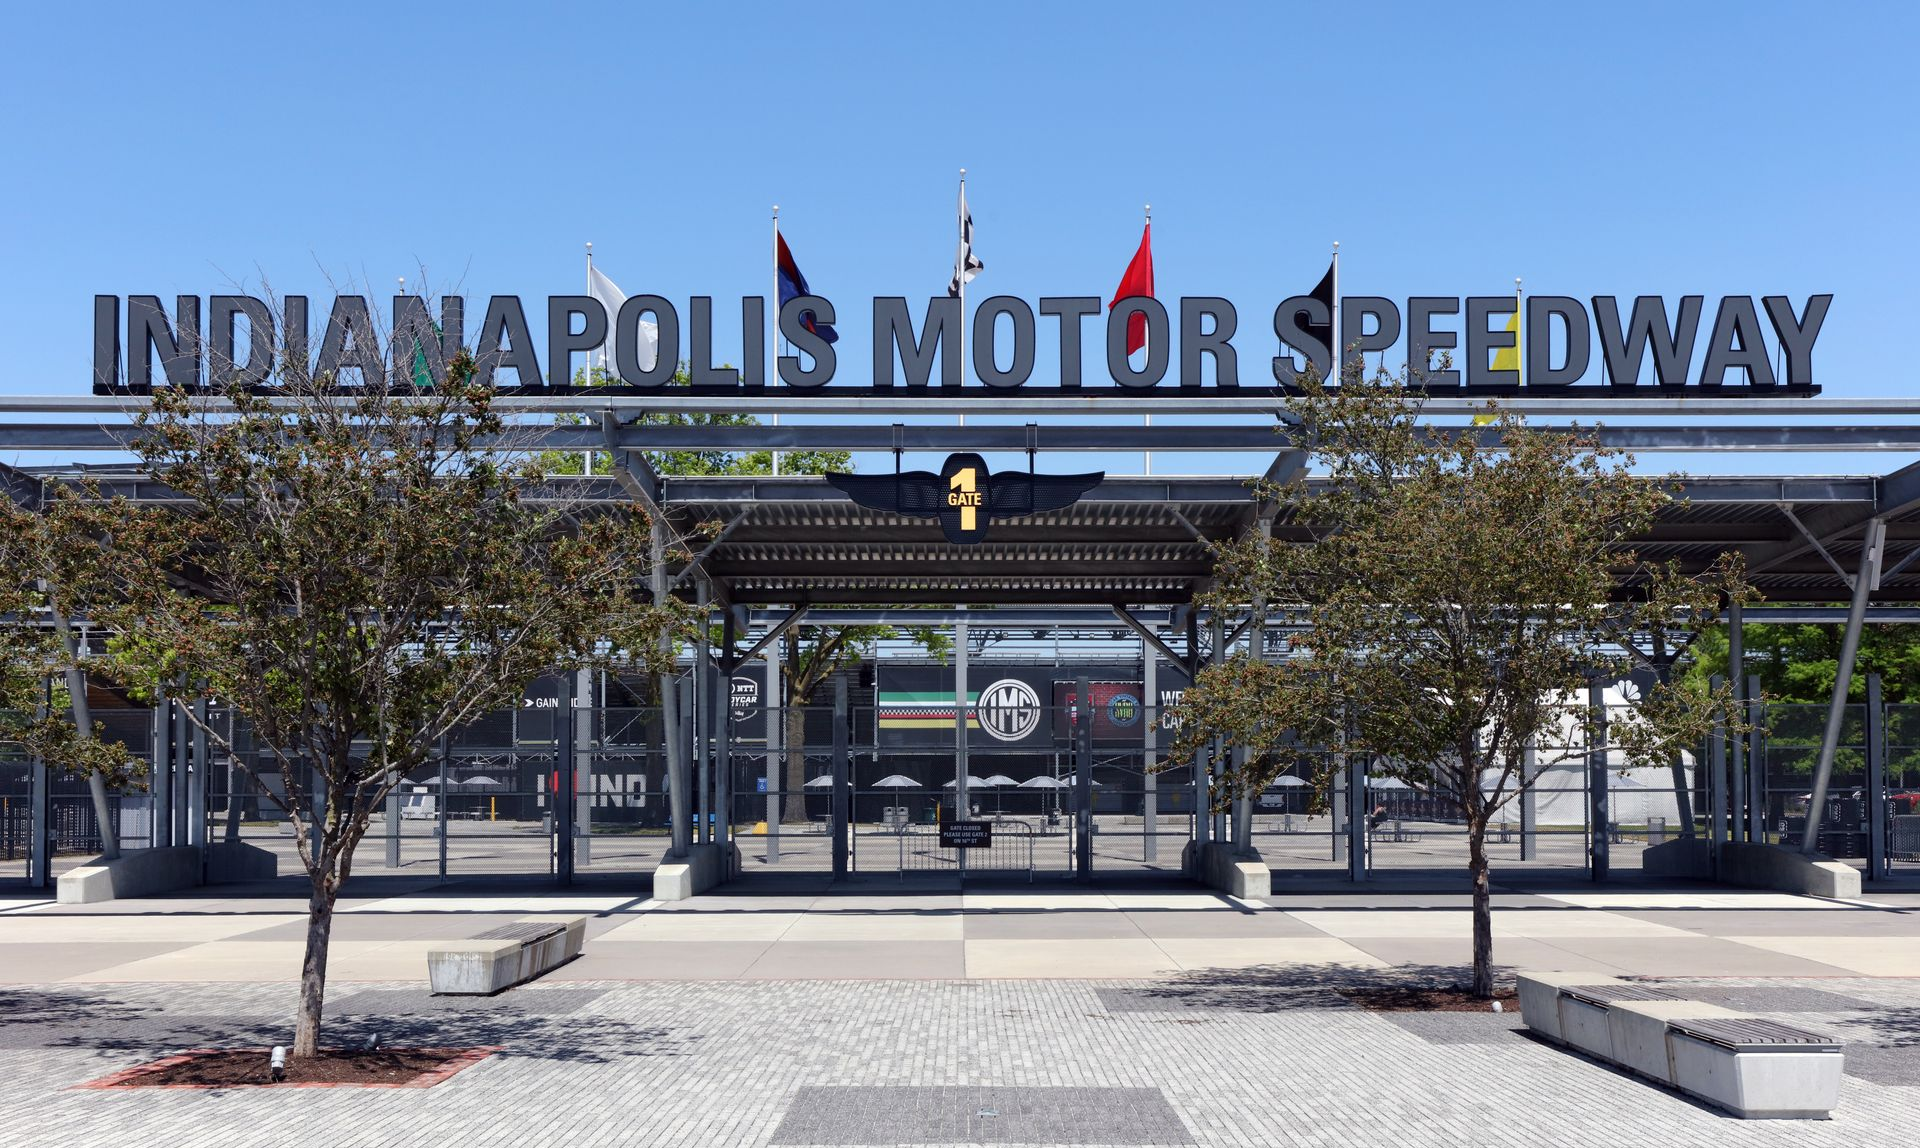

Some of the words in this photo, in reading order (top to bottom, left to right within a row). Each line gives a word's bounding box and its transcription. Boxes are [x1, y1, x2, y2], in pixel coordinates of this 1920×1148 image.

[93, 294, 837, 388] INDIANAPOLIS
[872, 294, 1241, 388] MOTOR
[1272, 293, 1834, 388] SPEEDWAY
[948, 491, 982, 506] GATE
[950, 467, 976, 530] 1
[990, 687, 1032, 732] IMS
[590, 774, 647, 807] IND
